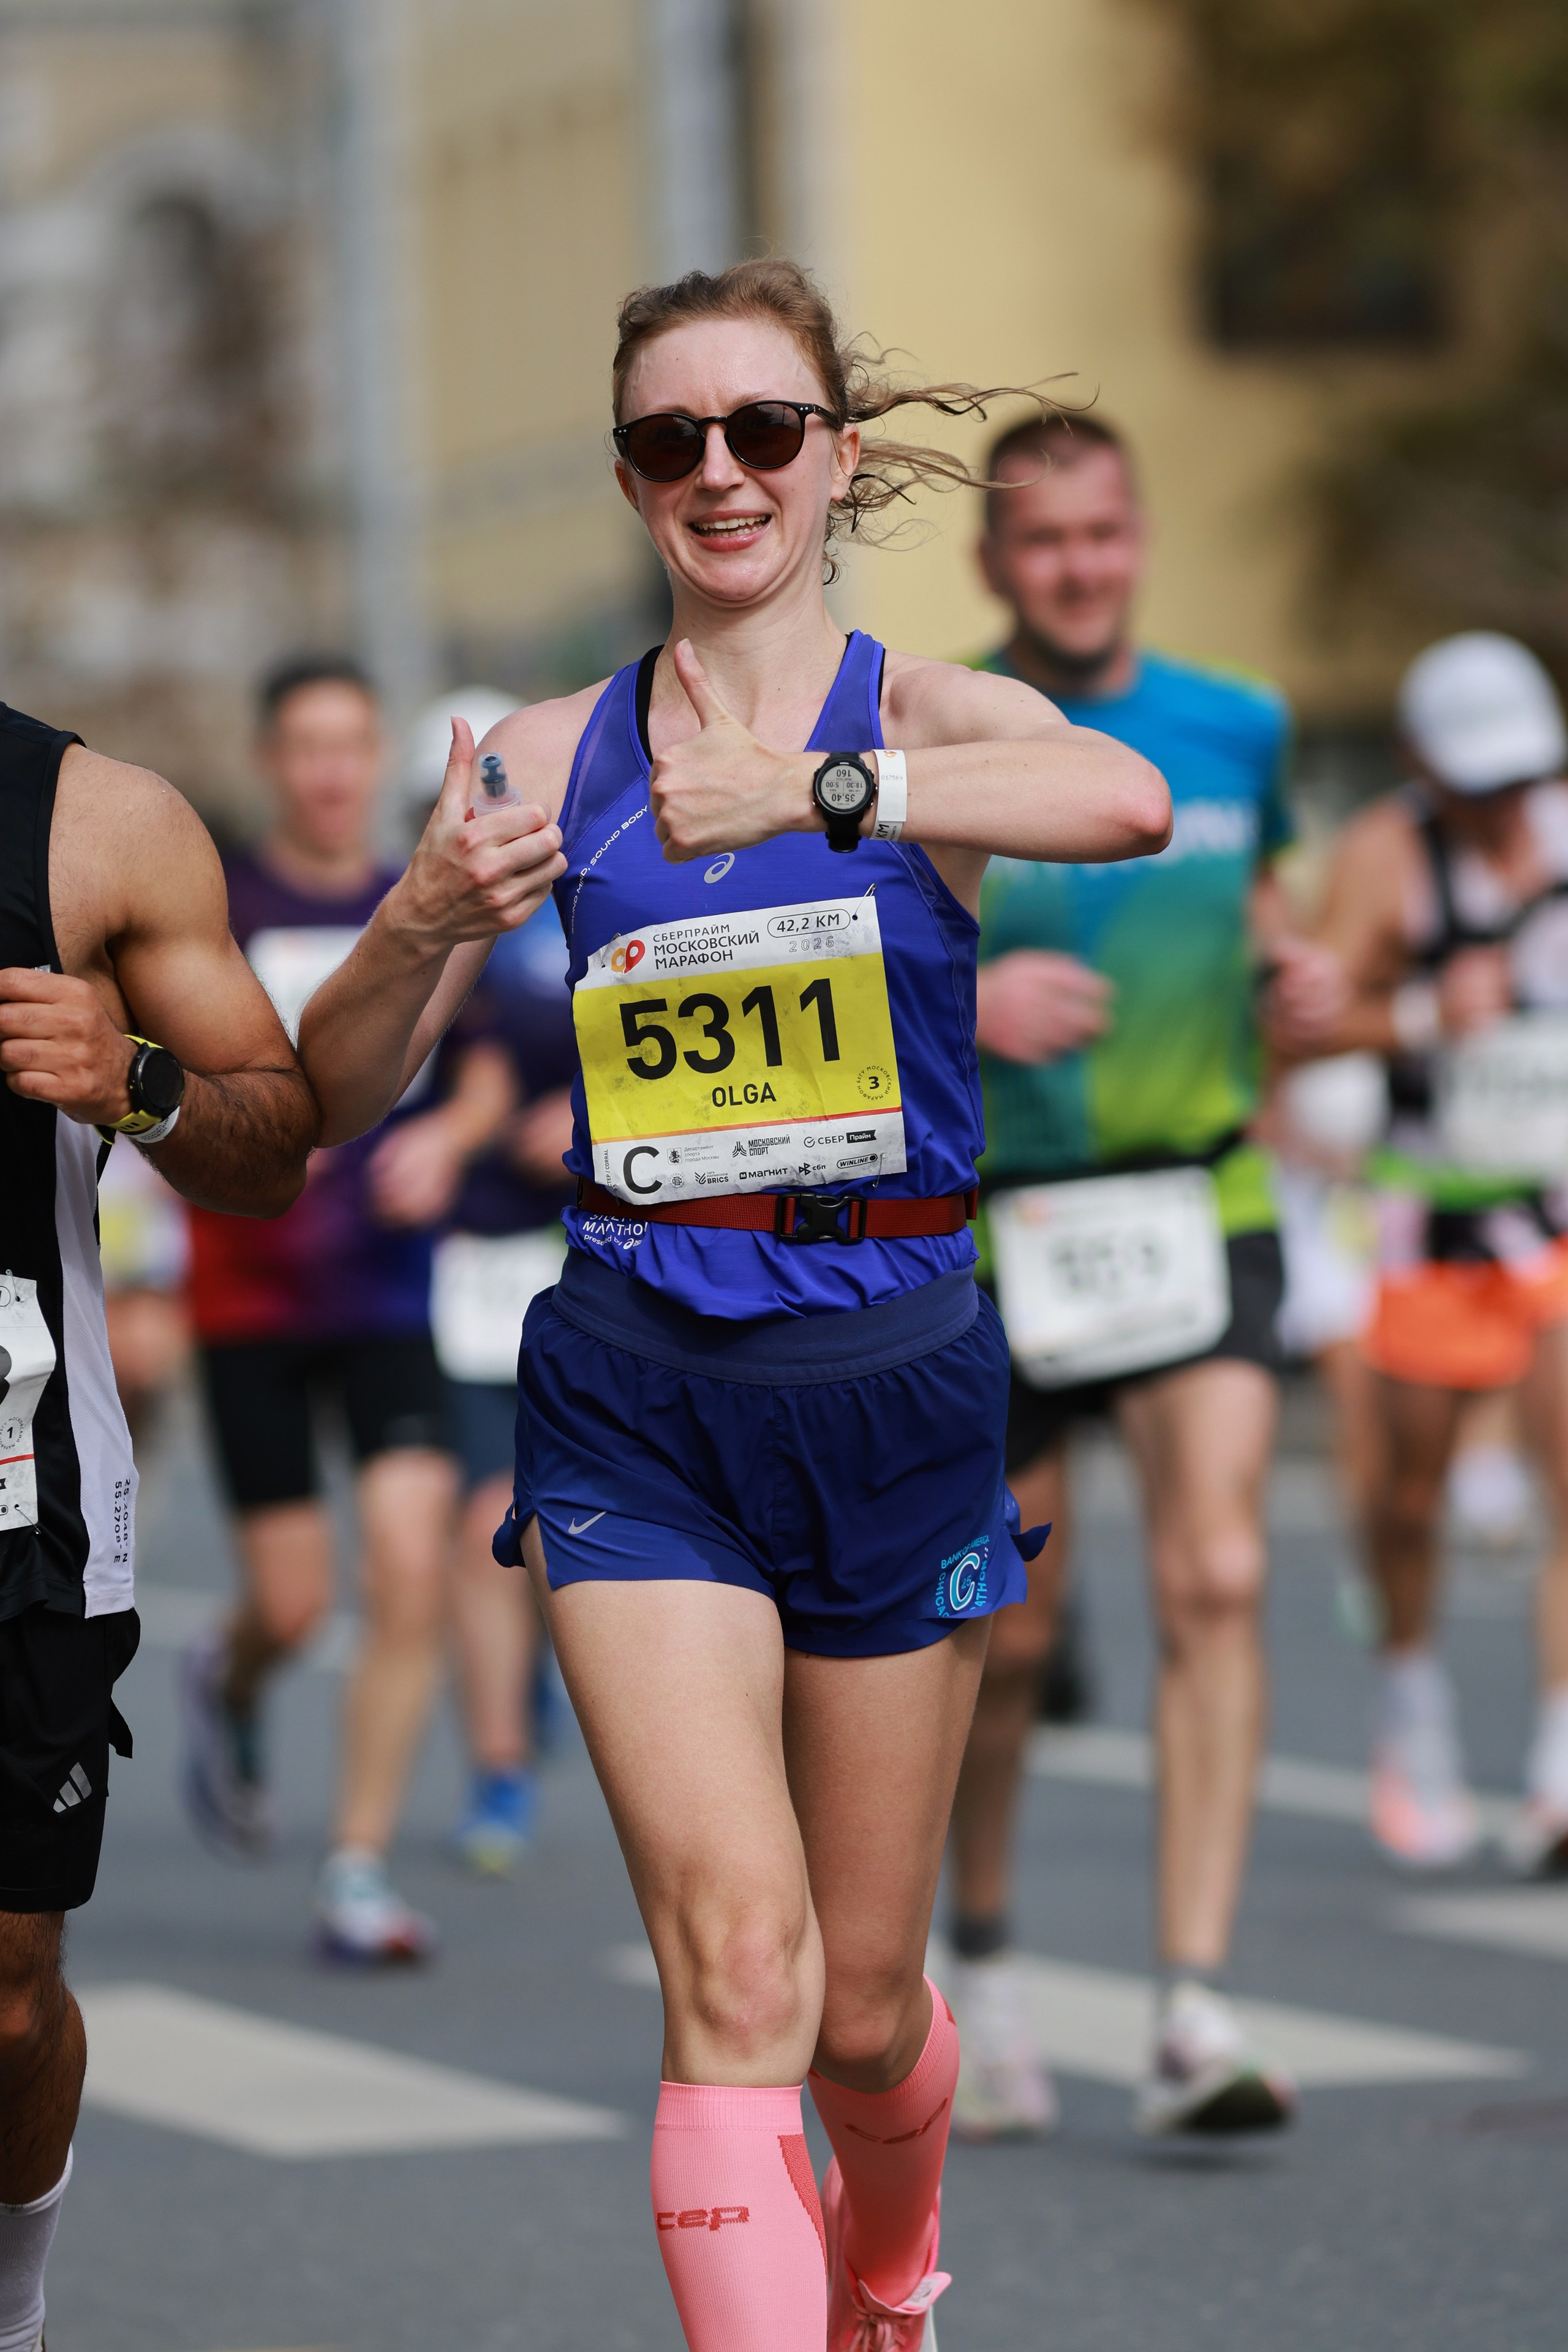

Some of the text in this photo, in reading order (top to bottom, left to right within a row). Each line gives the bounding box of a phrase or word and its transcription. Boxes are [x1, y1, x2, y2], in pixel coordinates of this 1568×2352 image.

[590, 830, 620, 865] SOUND
[621, 805, 647, 830] BODY
[777, 918, 809, 932] 42,2
[653, 924, 730, 943] СБЕРПРАЙМ
[654, 930, 760, 956] МОСКОВСКИЙ
[789, 935, 834, 952] 2026
[655, 949, 733, 970] МАРАФОН
[619, 978, 840, 1080] 5311
[869, 1076, 880, 1090] 3
[712, 1082, 777, 1108] OLGA
[748, 1134, 791, 1148] МОСКОВСКИЙ
[818, 1135, 845, 1145] СБЕР
[749, 1147, 769, 1156] СПОРТ
[840, 1156, 869, 1167] WINLINE
[623, 1145, 663, 1194] C
[748, 1168, 788, 1178] магнит
[614, 1237, 622, 1246] by
[7, 1427, 13, 1439] 1
[123, 1552, 127, 1562] N
[941, 1534, 989, 1569] BANK OF AMERICA
[961, 1575, 972, 1589] 25
[657, 2207, 750, 2231] cep
